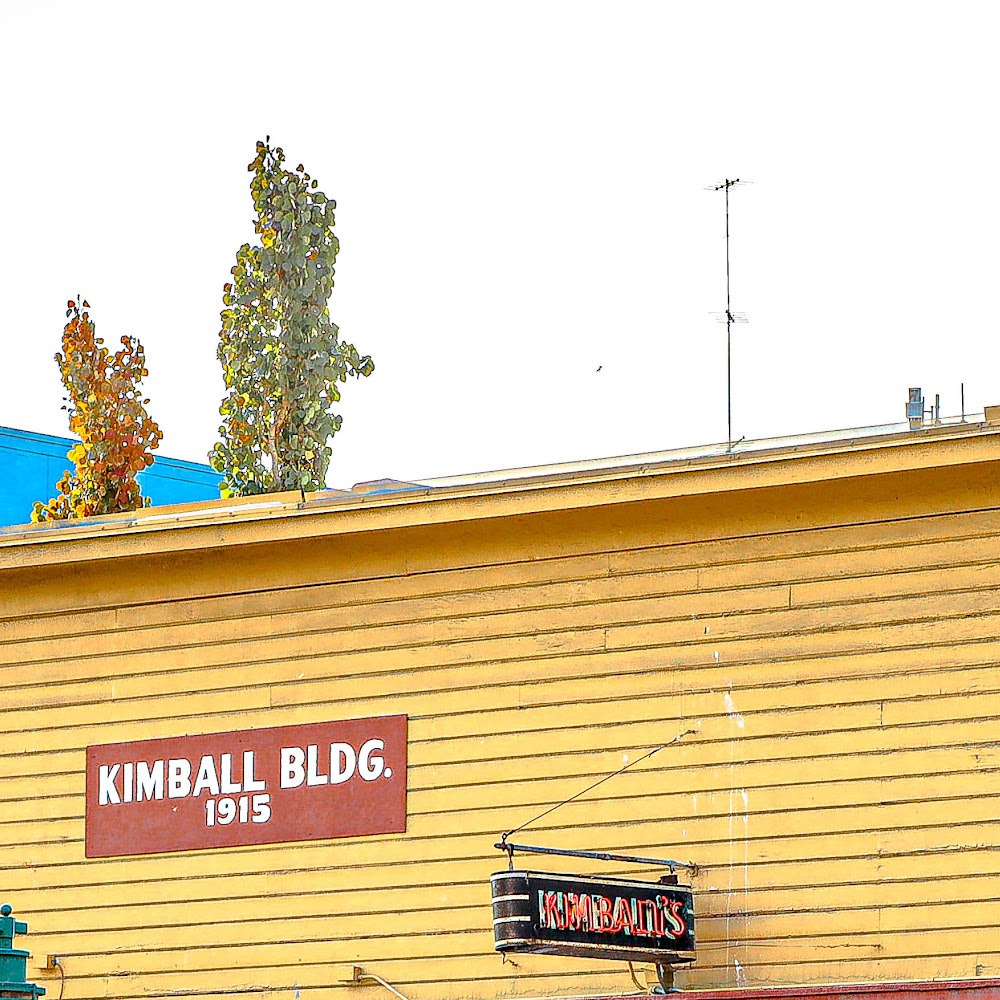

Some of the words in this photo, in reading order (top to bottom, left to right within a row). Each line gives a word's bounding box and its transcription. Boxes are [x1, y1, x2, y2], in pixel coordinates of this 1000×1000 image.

[98, 751, 266, 806] KIMBALL
[280, 739, 393, 789] BLDG.
[205, 794, 271, 827] 1915
